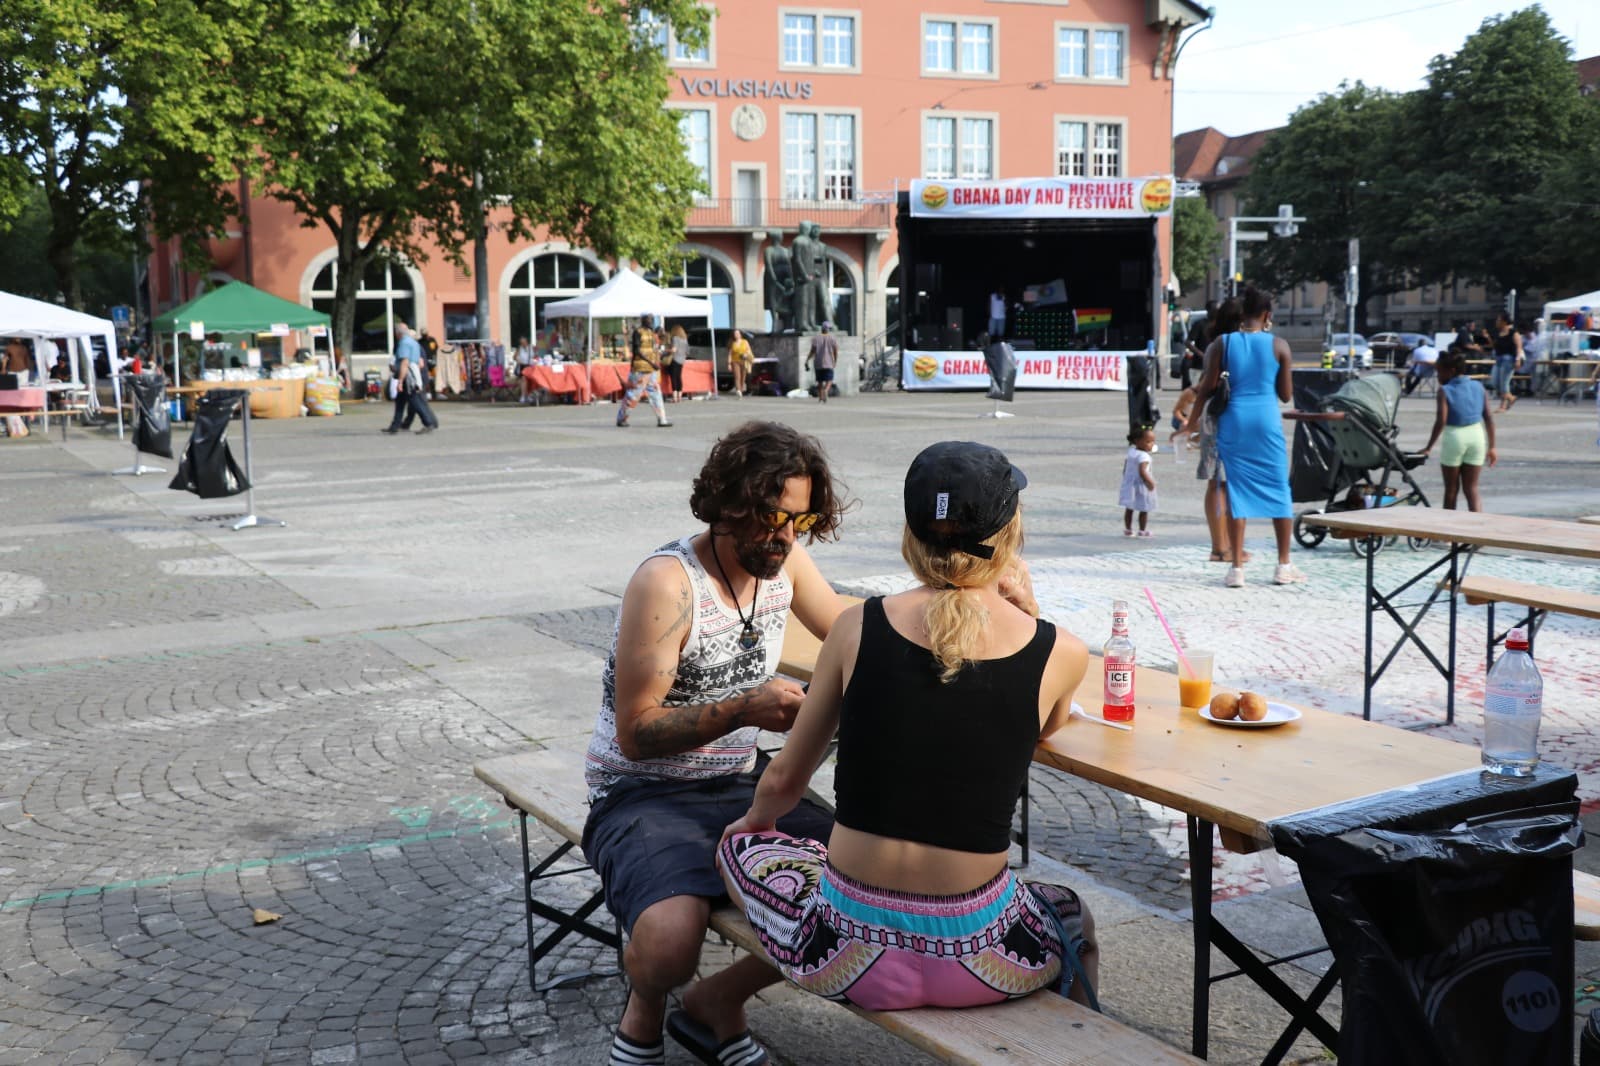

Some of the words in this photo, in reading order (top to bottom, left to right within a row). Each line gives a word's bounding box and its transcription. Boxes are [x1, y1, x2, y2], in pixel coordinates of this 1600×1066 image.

[681, 77, 813, 99] VOLKSHAUS
[1068, 182, 1134, 196] HIGHLIFE
[953, 187, 1001, 206] GHANA
[1005, 187, 1031, 205] DAY
[1035, 187, 1063, 205] AND
[1068, 196, 1134, 210] FESTIVAL
[943, 358, 990, 375] GHANA
[1024, 358, 1052, 374] AND
[1057, 355, 1121, 368] HIGHLIFE
[1056, 367, 1121, 382] FESTIVAL
[1111, 673, 1128, 682] ICE
